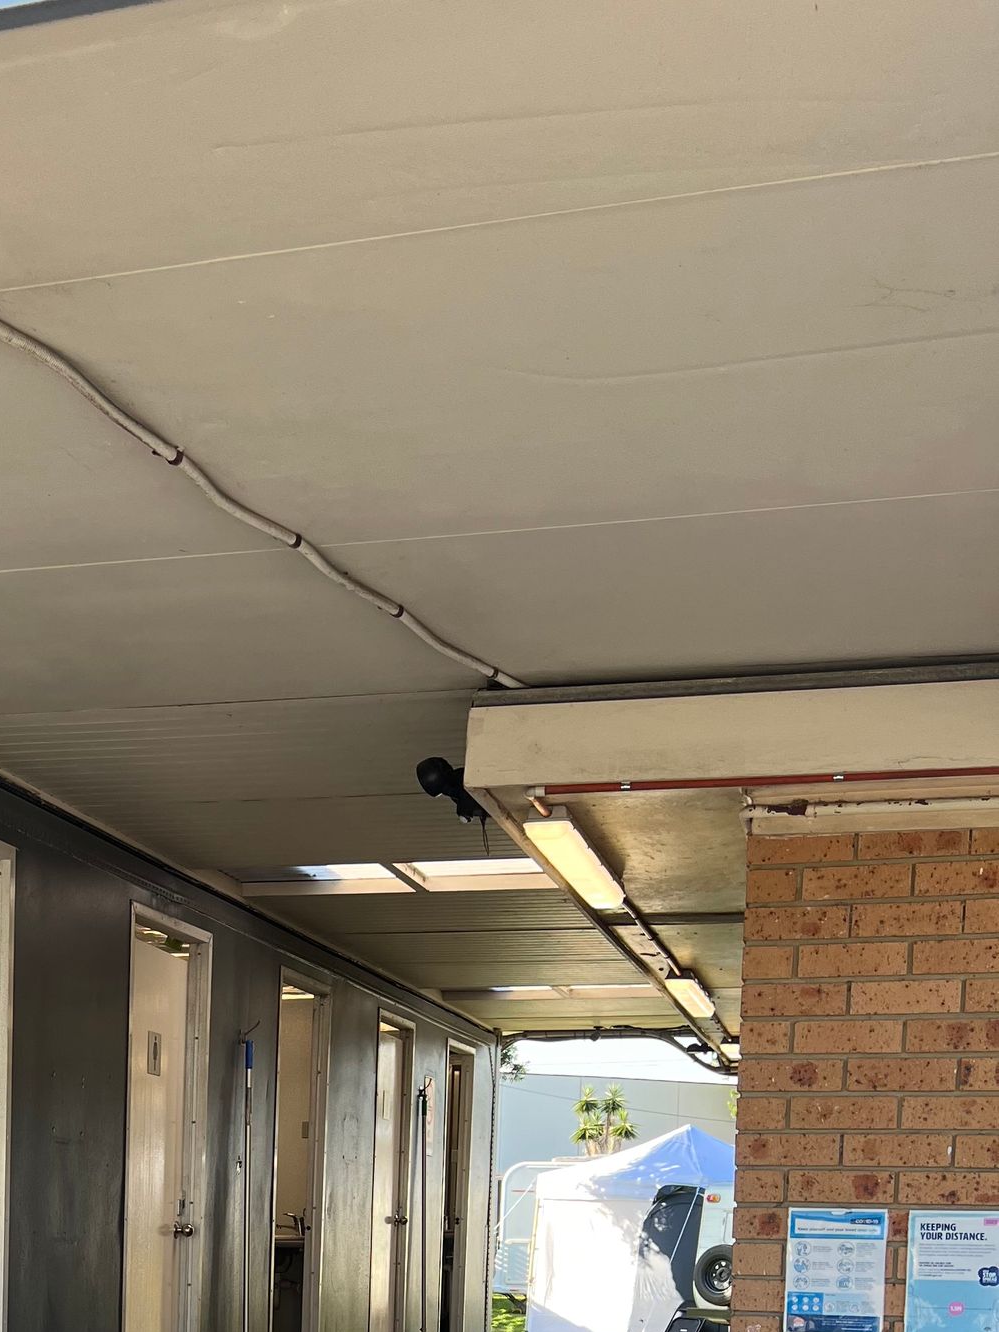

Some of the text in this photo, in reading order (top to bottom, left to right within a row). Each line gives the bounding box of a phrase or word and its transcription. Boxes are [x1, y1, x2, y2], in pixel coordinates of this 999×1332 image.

[920, 1223, 956, 1231] KEEPING
[921, 1232, 987, 1240] YOUR DISTANCE.
